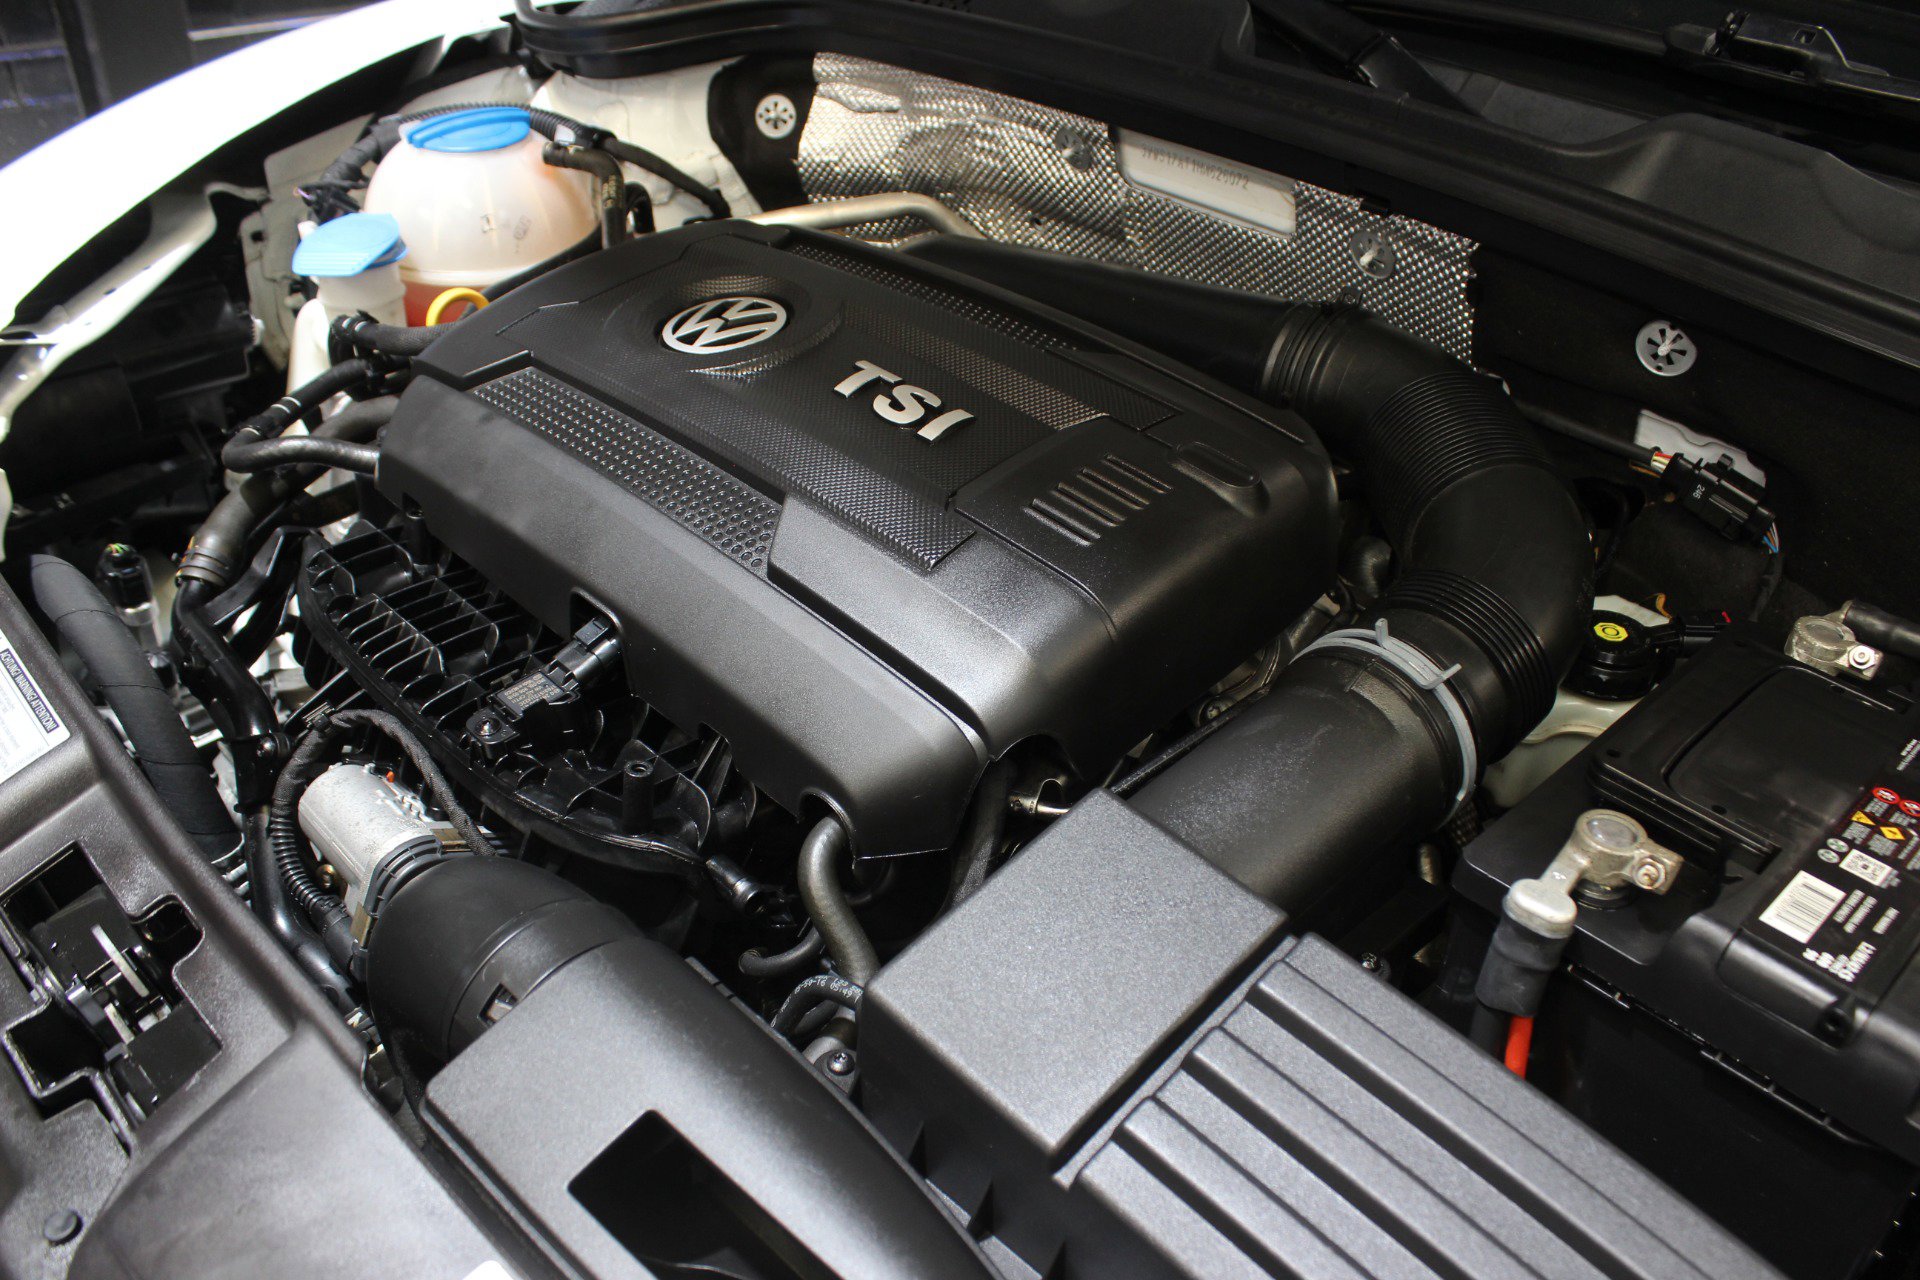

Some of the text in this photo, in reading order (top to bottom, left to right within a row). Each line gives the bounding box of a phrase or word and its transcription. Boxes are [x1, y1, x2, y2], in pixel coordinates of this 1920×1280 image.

[833, 359, 975, 442] TSI
[1692, 483, 1705, 499] 246
[14, 673, 37, 703] WARNING!
[29, 697, 57, 733] ATTENTION!
